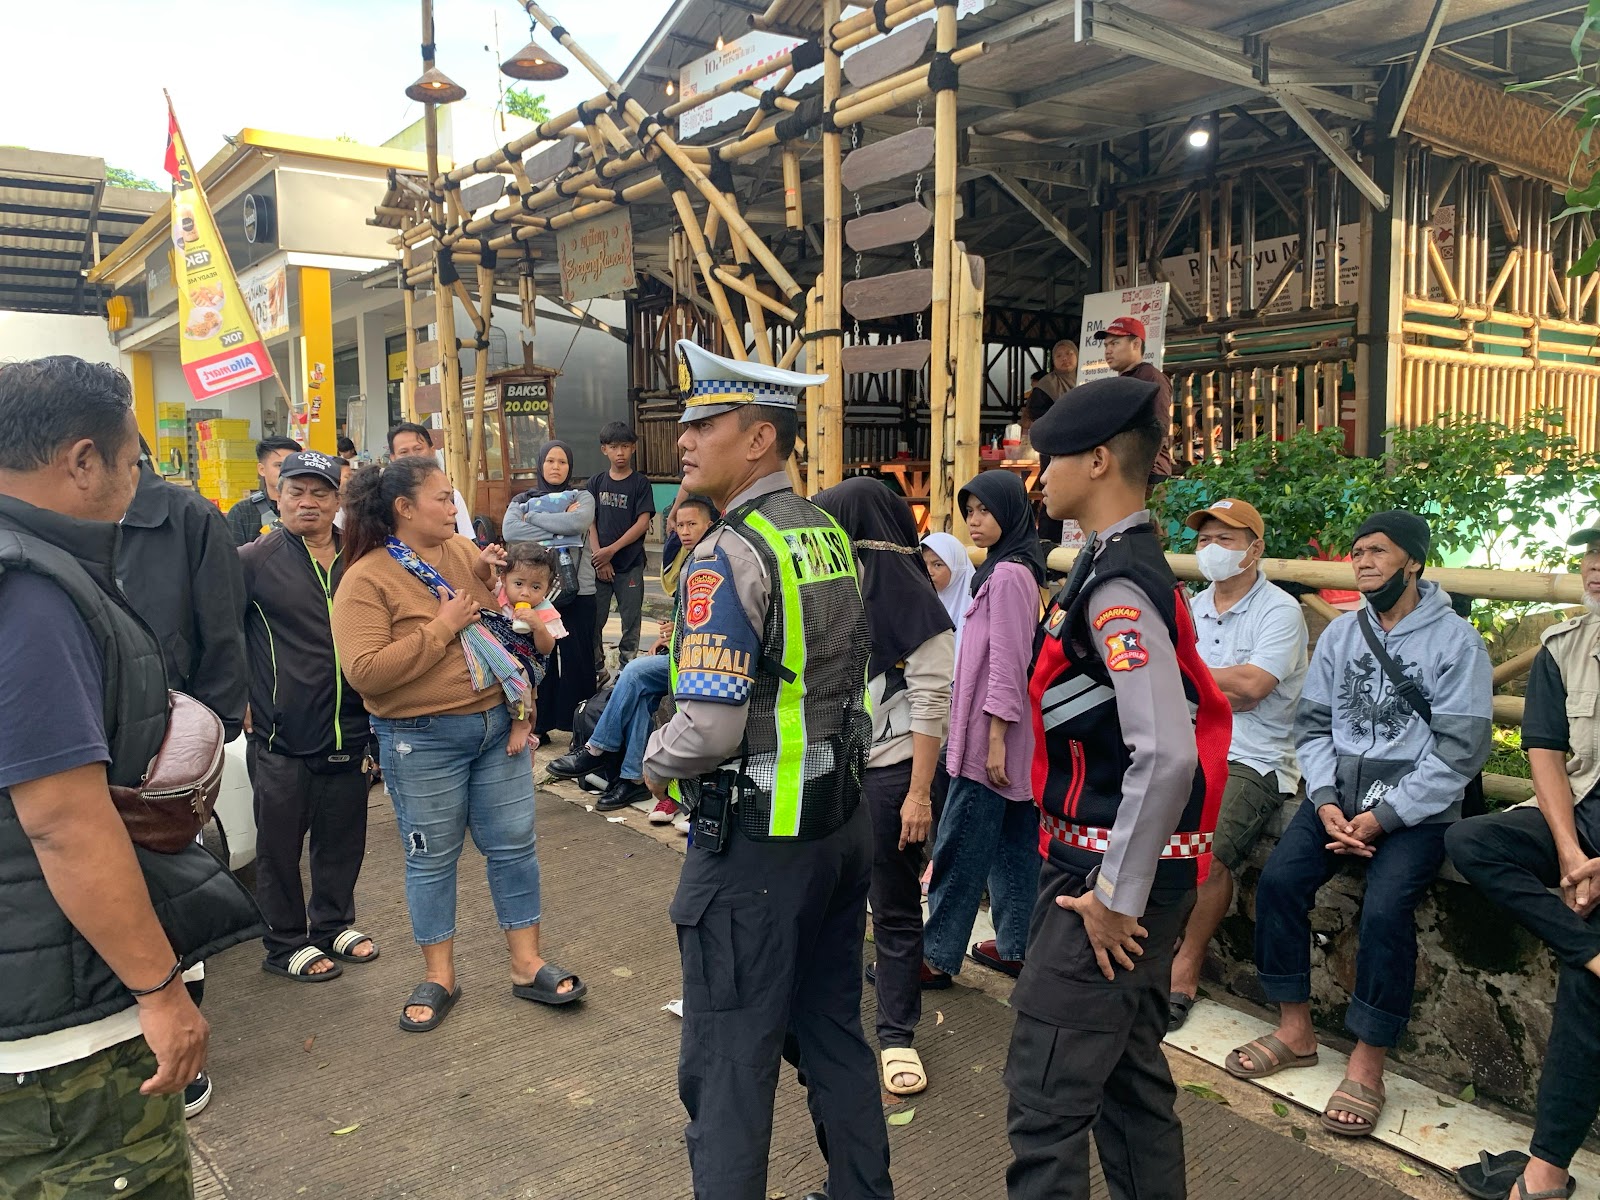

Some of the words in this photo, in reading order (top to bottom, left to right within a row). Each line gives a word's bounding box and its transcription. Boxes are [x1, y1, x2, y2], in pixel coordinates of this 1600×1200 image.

[1230, 249, 1277, 271] Kyu
[1282, 237, 1346, 261] Mns
[1085, 336, 1103, 348] Kay
[508, 385, 546, 397] BAKSO
[505, 400, 549, 412] 20.000
[304, 461, 326, 470] SONS
[1096, 608, 1138, 626] BAHARKAM
